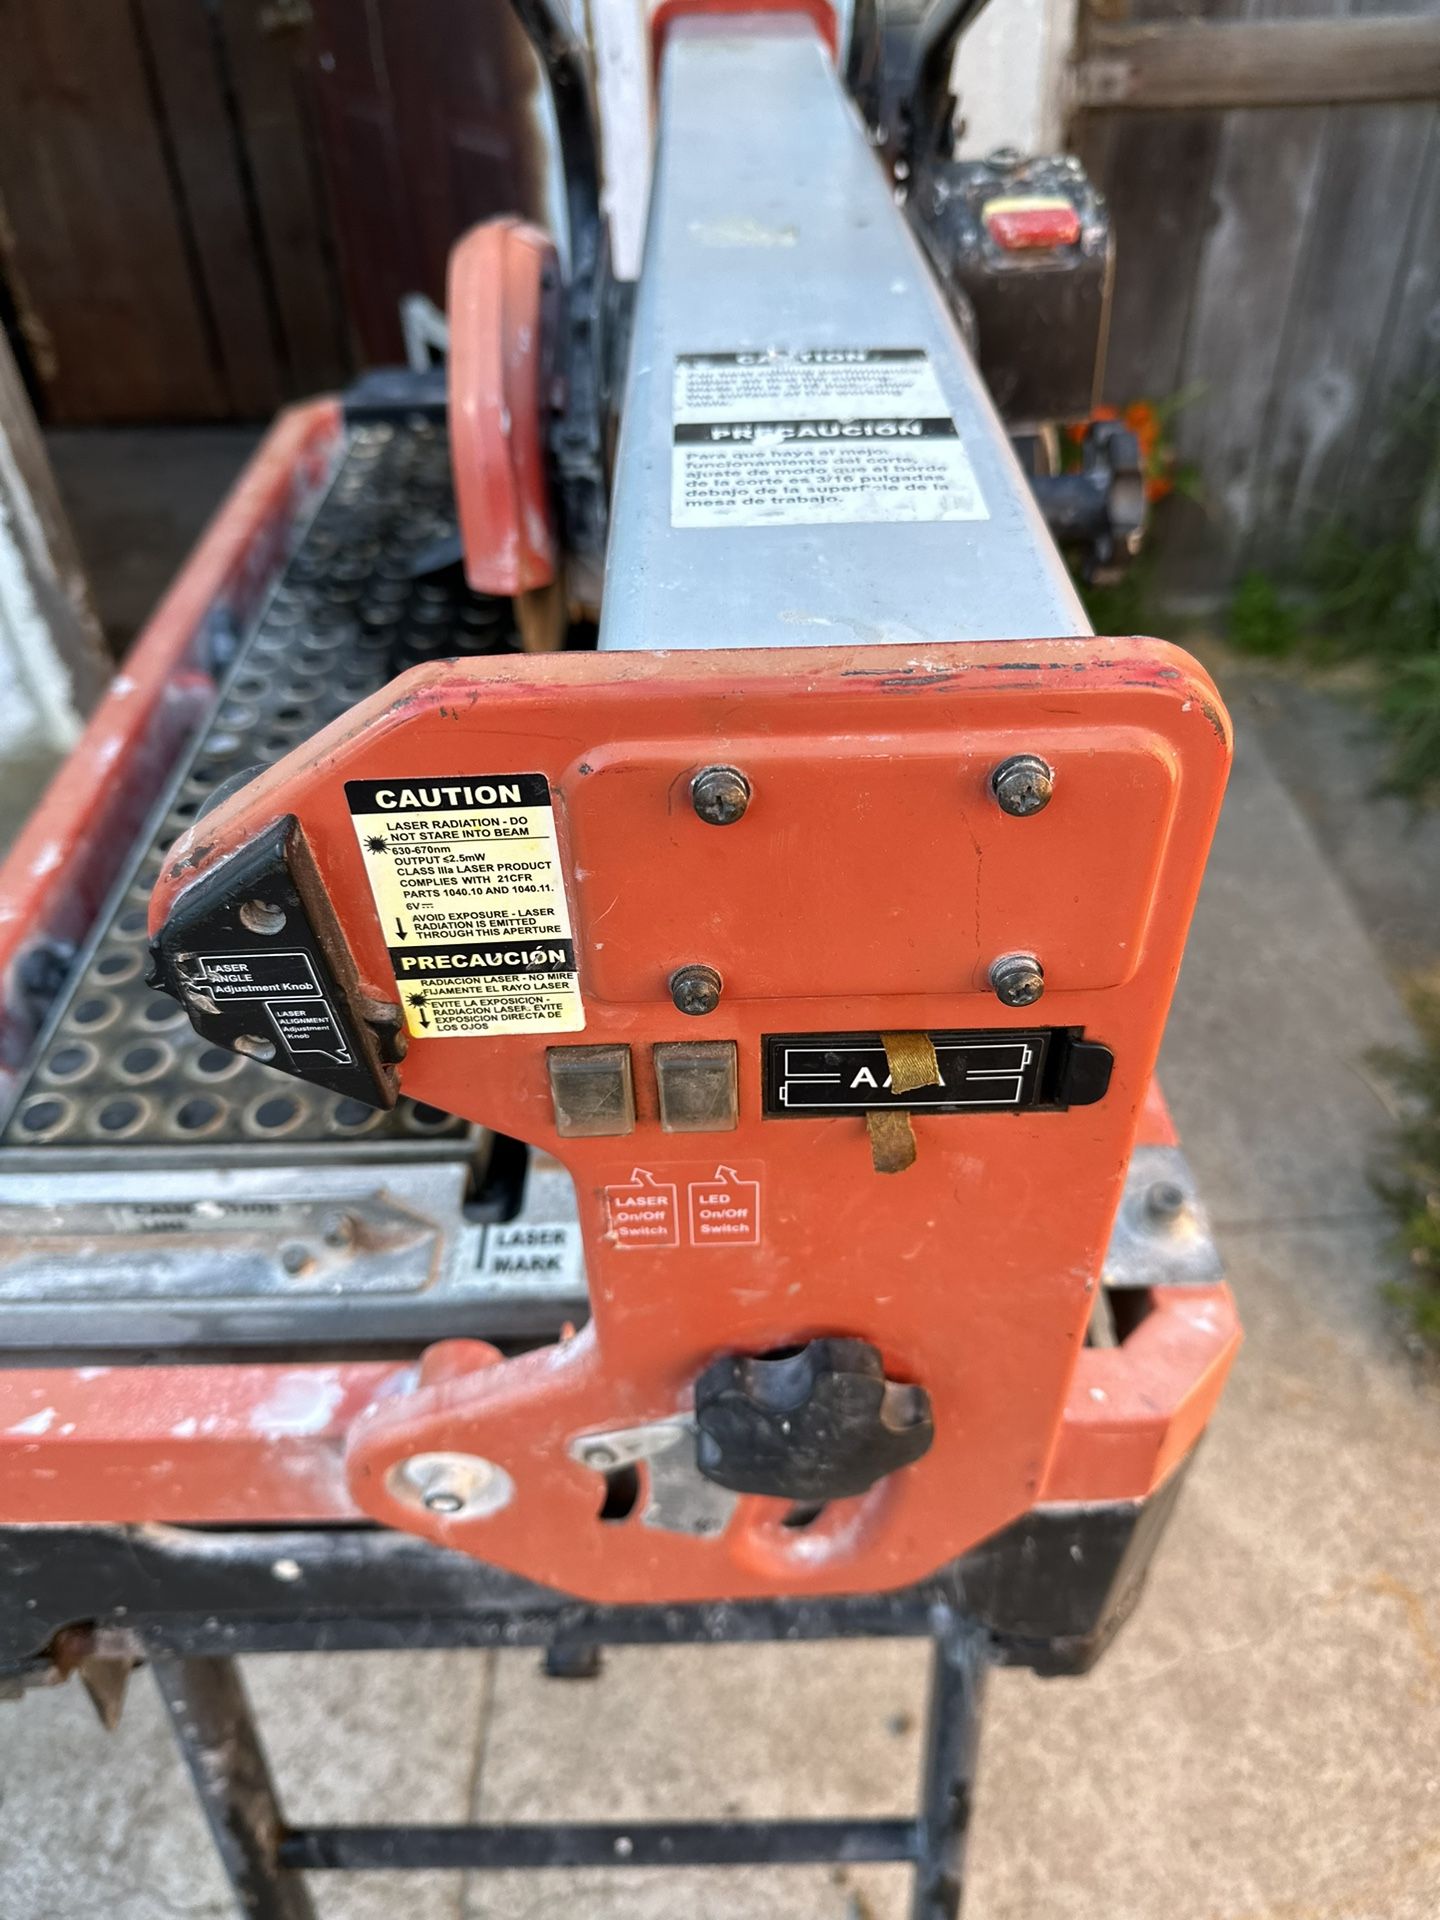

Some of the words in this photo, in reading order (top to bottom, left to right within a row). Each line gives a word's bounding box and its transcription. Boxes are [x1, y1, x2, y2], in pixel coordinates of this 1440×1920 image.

[736, 350, 865, 366] CATION
[686, 452, 726, 460] Para
[732, 451, 765, 460] que
[686, 459, 827, 469] funcionamiento
[686, 470, 741, 479] ajuste
[775, 467, 827, 475] modo
[833, 467, 867, 475] que
[873, 465, 888, 473] el
[686, 480, 708, 488] de
[736, 478, 783, 486] corte
[816, 475, 854, 483] 3/16
[860, 474, 945, 483] pulgadas
[686, 489, 749, 498] debajo
[755, 487, 777, 495] de
[784, 486, 799, 494] la
[807, 484, 899, 494] superfcie
[933, 483, 949, 491] la
[686, 499, 736, 507] mesa
[771, 495, 843, 504] trabajo.
[375, 784, 522, 809] CAUTION
[386, 820, 429, 831] LASER
[432, 817, 500, 829] RADIATION
[510, 816, 528, 825] DO
[390, 832, 415, 841] NOT
[419, 830, 459, 841] STARE
[463, 829, 490, 839] INTO
[494, 827, 529, 837] BEAM
[392, 846, 451, 855] 630-670nm
[394, 856, 440, 866] OUTPUT
[397, 867, 435, 876] CLASS
[438, 866, 454, 875] IIIa
[456, 864, 494, 874] LASER
[497, 861, 552, 872] PRODUCT
[399, 877, 458, 887] COMPLIES
[462, 876, 491, 885] WITH
[497, 874, 533, 883] 21CFR
[403, 889, 440, 899] PARTS
[443, 887, 483, 897] 1040.10
[485, 886, 509, 895] AND
[512, 884, 554, 894] 1040.11.
[412, 913, 446, 922] AVOID
[448, 910, 509, 921] EXPOSURE
[518, 908, 555, 917] LASER
[414, 920, 473, 931] RADIATION
[476, 920, 486, 928] IS
[489, 917, 537, 927] EMITTED
[416, 930, 474, 939] THROUGH
[475, 928, 500, 937] THIS
[502, 925, 561, 935] APERTURE
[401, 946, 566, 970] PRECAUCIÓN
[207, 964, 249, 973] LASER
[212, 974, 254, 983] ANGLE
[420, 977, 481, 987] RADIACION
[483, 975, 520, 983] LASER
[548, 972, 574, 980] MIRE
[216, 984, 280, 994] Adjustment
[282, 983, 314, 991] Knob
[423, 986, 483, 996] FIJAMENTE
[485, 985, 500, 993] EL
[501, 983, 532, 992] RAYO
[534, 981, 570, 990] LASER
[431, 1000, 461, 1009] EVITE
[464, 999, 477, 1007] LA
[480, 996, 544, 1006] EXPOSICION
[433, 1007, 491, 1016] RADIACION
[534, 1003, 564, 1011] EVITE
[435, 1014, 498, 1024] EXPOSICION
[501, 1012, 545, 1021] DIRECTA
[548, 1011, 562, 1019] DE
[283, 1025, 330, 1033] Adjustment
[437, 1024, 458, 1032] LOS
[460, 1023, 489, 1031] OJOS
[615, 1195, 669, 1208] LASER
[699, 1194, 731, 1205] LED
[617, 1210, 666, 1222] On/Off
[700, 1209, 749, 1219] On/Off
[618, 1225, 668, 1236] Switch
[701, 1223, 749, 1234] Switch
[496, 1228, 566, 1246] LASER
[494, 1254, 562, 1273] MARK
